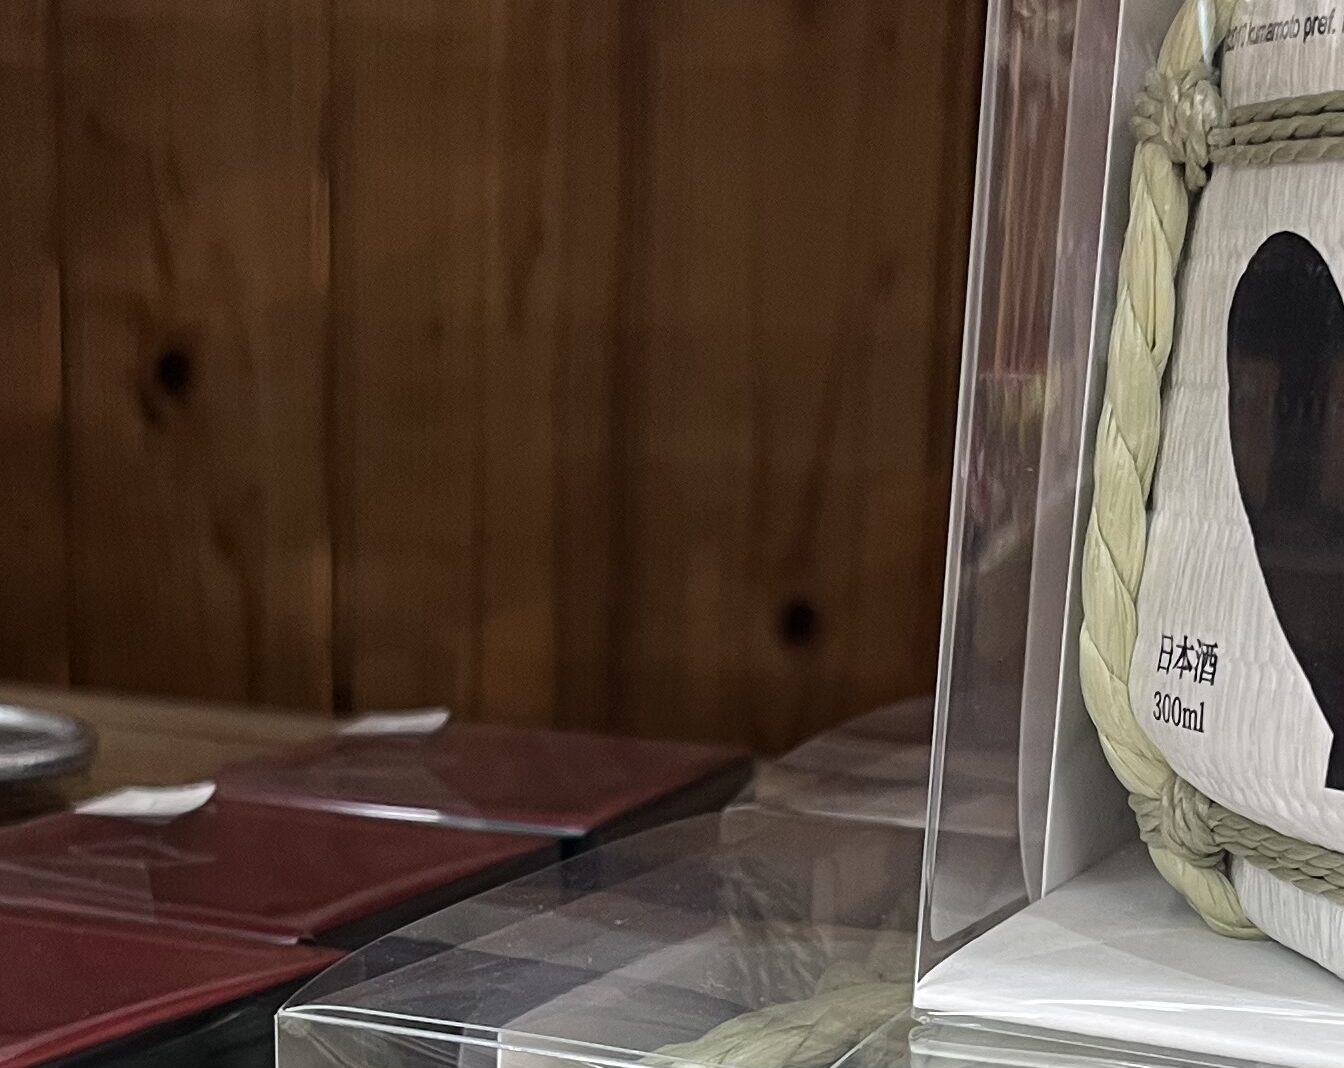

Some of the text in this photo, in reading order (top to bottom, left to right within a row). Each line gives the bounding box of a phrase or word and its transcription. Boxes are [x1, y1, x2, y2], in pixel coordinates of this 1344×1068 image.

[1303, 8, 1336, 44] pref.
[1156, 634, 1218, 686] 日本酒
[1152, 690, 1205, 733] 300ml
